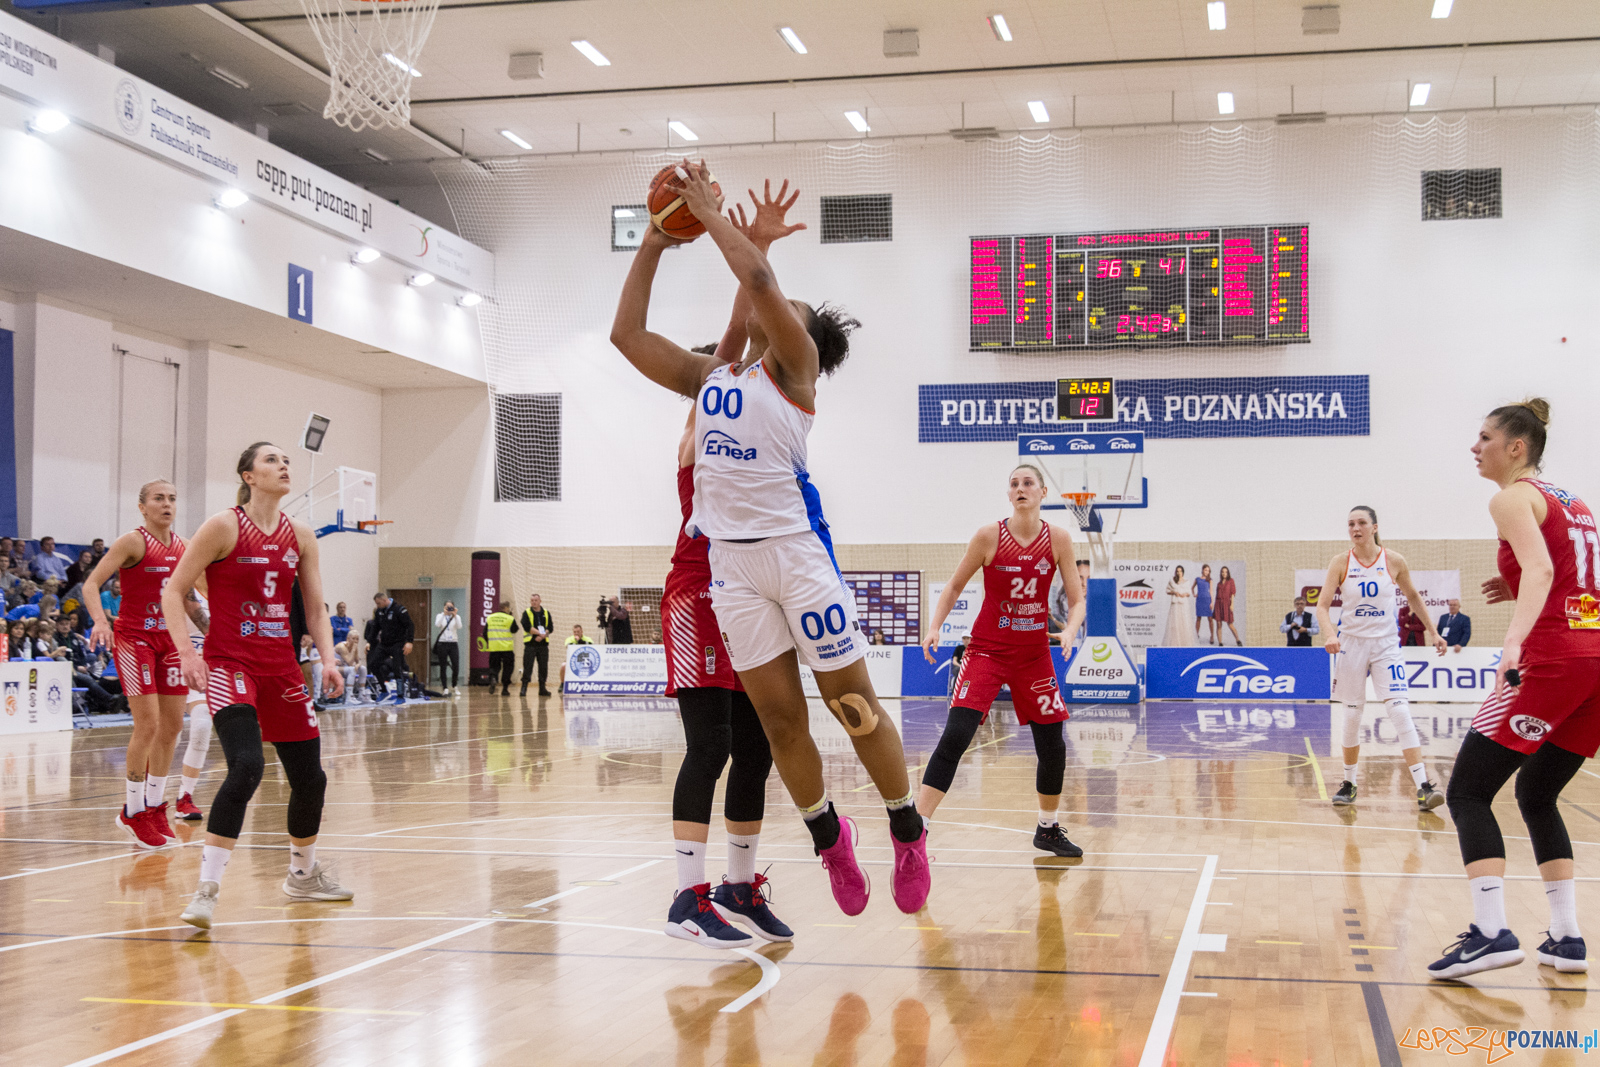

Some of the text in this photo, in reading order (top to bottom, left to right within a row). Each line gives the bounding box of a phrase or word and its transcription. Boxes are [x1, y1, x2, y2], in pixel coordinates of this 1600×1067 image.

[151, 98, 210, 140] Centrum Sportu
[150, 122, 238, 178] Politechniki Poznańskiej
[256, 159, 372, 232] cspp.put.poznan.pl
[1078, 236, 1096, 245] AZS
[1185, 231, 1210, 241] WLKP
[1096, 259, 1122, 278] 36
[1158, 258, 1185, 275] 41
[1211, 258, 1218, 268] 3
[1133, 267, 1141, 277] 3
[296, 274, 306, 316] 1
[1076, 291, 1084, 301] 2
[1211, 287, 1218, 296] 4
[1089, 317, 1096, 325] 4
[1178, 313, 1186, 323] 3
[1069, 381, 1110, 394] 2.42.3
[703, 386, 742, 419] 00
[1080, 397, 1099, 415] 12
[1164, 388, 1347, 422] POZNAŃSKA
[705, 440, 757, 461] Enea
[1111, 442, 1136, 450] Enea
[1568, 527, 1600, 590] 11
[263, 571, 279, 598] 5
[1010, 577, 1038, 599] 24
[1358, 581, 1379, 598] 10
[480, 578, 496, 626] Energa
[1119, 590, 1155, 600] SHARK
[1425, 598, 1449, 606] obiet
[1019, 601, 1042, 610] OSTRÓW
[800, 603, 846, 641] 00
[1079, 666, 1123, 680] Energa
[1388, 664, 1405, 680] 10
[568, 682, 609, 692] Wybierz
[611, 683, 646, 691] zawód
[1196, 669, 1296, 693] Enea
[1037, 691, 1065, 716] 24
[305, 699, 318, 727] 5
